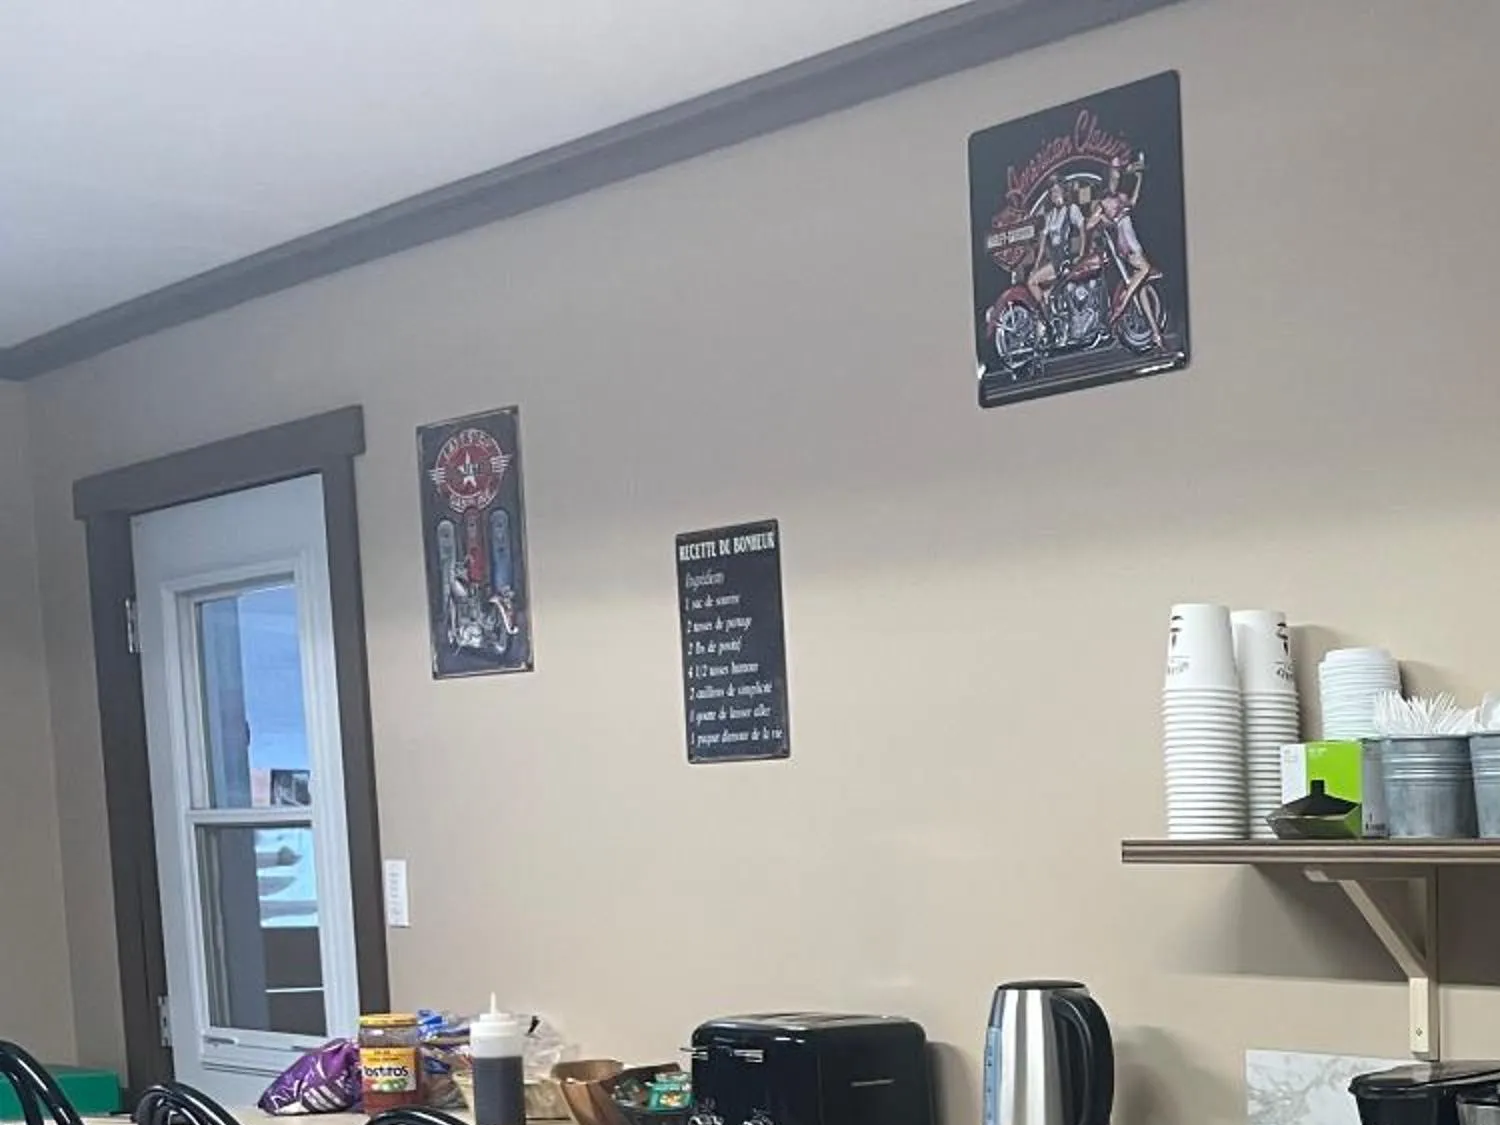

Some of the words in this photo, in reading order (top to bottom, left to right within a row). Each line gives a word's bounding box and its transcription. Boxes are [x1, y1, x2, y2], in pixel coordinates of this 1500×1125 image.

[679, 541, 717, 561] RECETTE
[733, 532, 775, 554] BONHEUR
[704, 594, 714, 607] de
[715, 616, 724, 630] de
[708, 640, 717, 653] de
[726, 683, 736, 697] de
[718, 705, 727, 720] de
[751, 727, 760, 741] de
